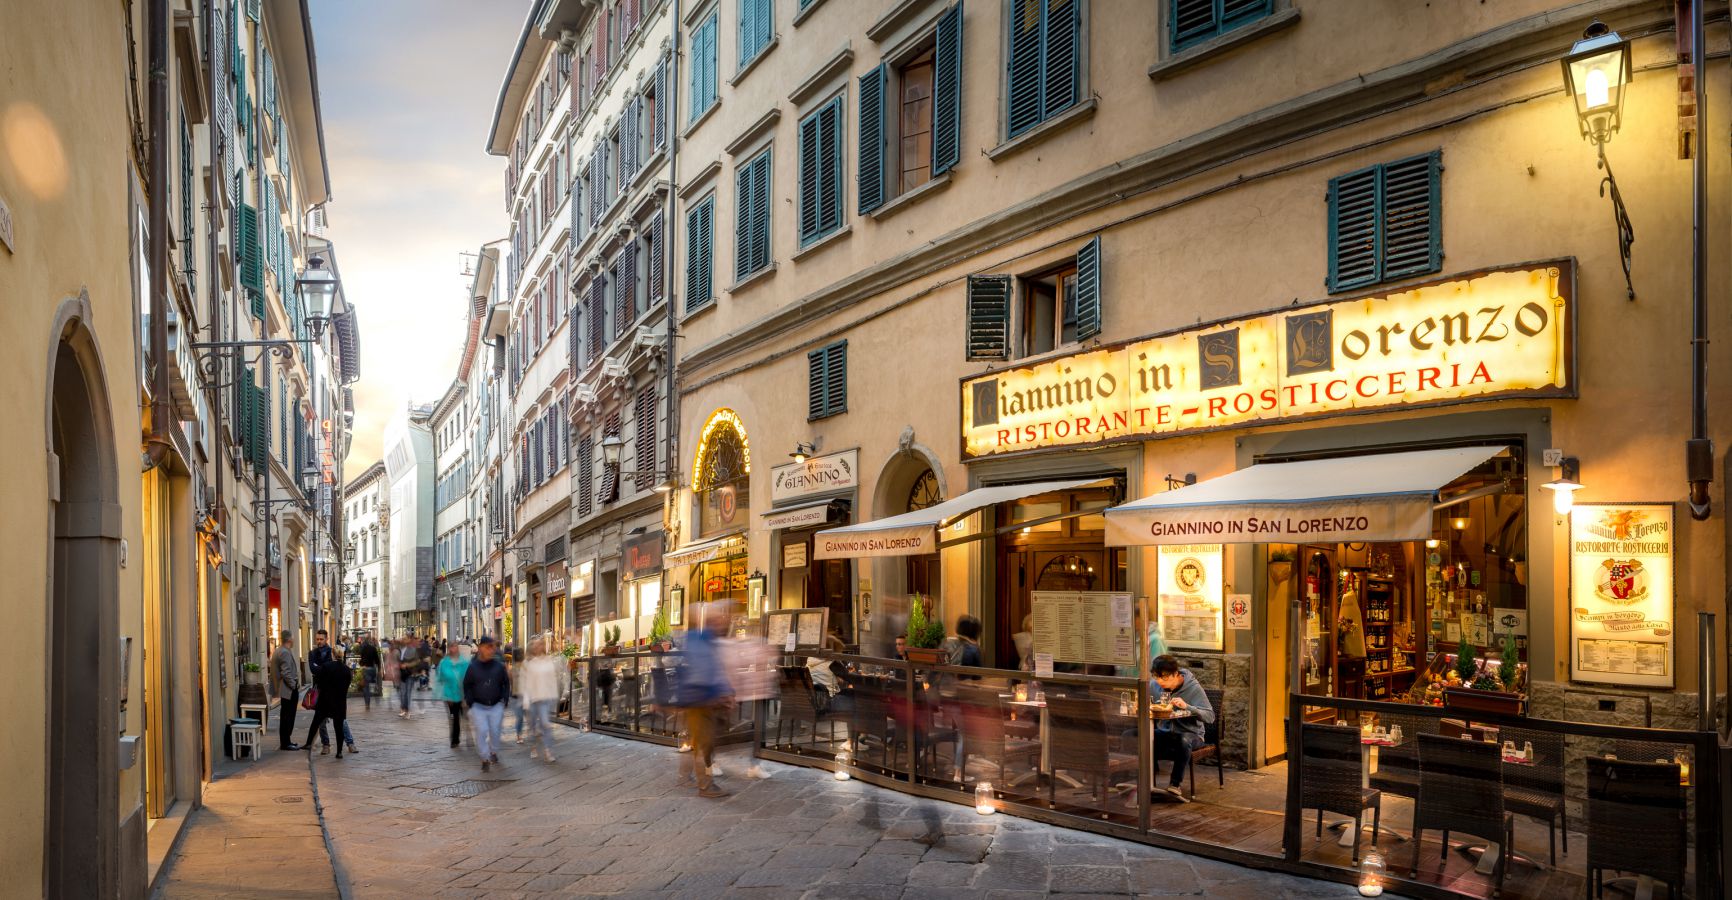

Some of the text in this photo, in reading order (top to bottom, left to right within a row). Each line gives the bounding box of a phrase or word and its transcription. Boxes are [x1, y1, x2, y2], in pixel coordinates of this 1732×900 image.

[974, 366, 1116, 427] Giannino
[1138, 353, 1172, 394] in
[1287, 301, 1549, 375] Lorenzo
[997, 405, 1171, 447] RISTORANTE
[1208, 361, 1494, 418] ROSTICCERIA
[1545, 451, 1561, 464] 37
[785, 469, 840, 489] GIANNINO
[768, 517, 786, 526] GIANNINO
[801, 512, 821, 521] LORENZO
[1151, 516, 1369, 536] GIANNINO IN SAN LORENZO
[825, 537, 921, 552] GIANNINO IN SAN LORENZO
